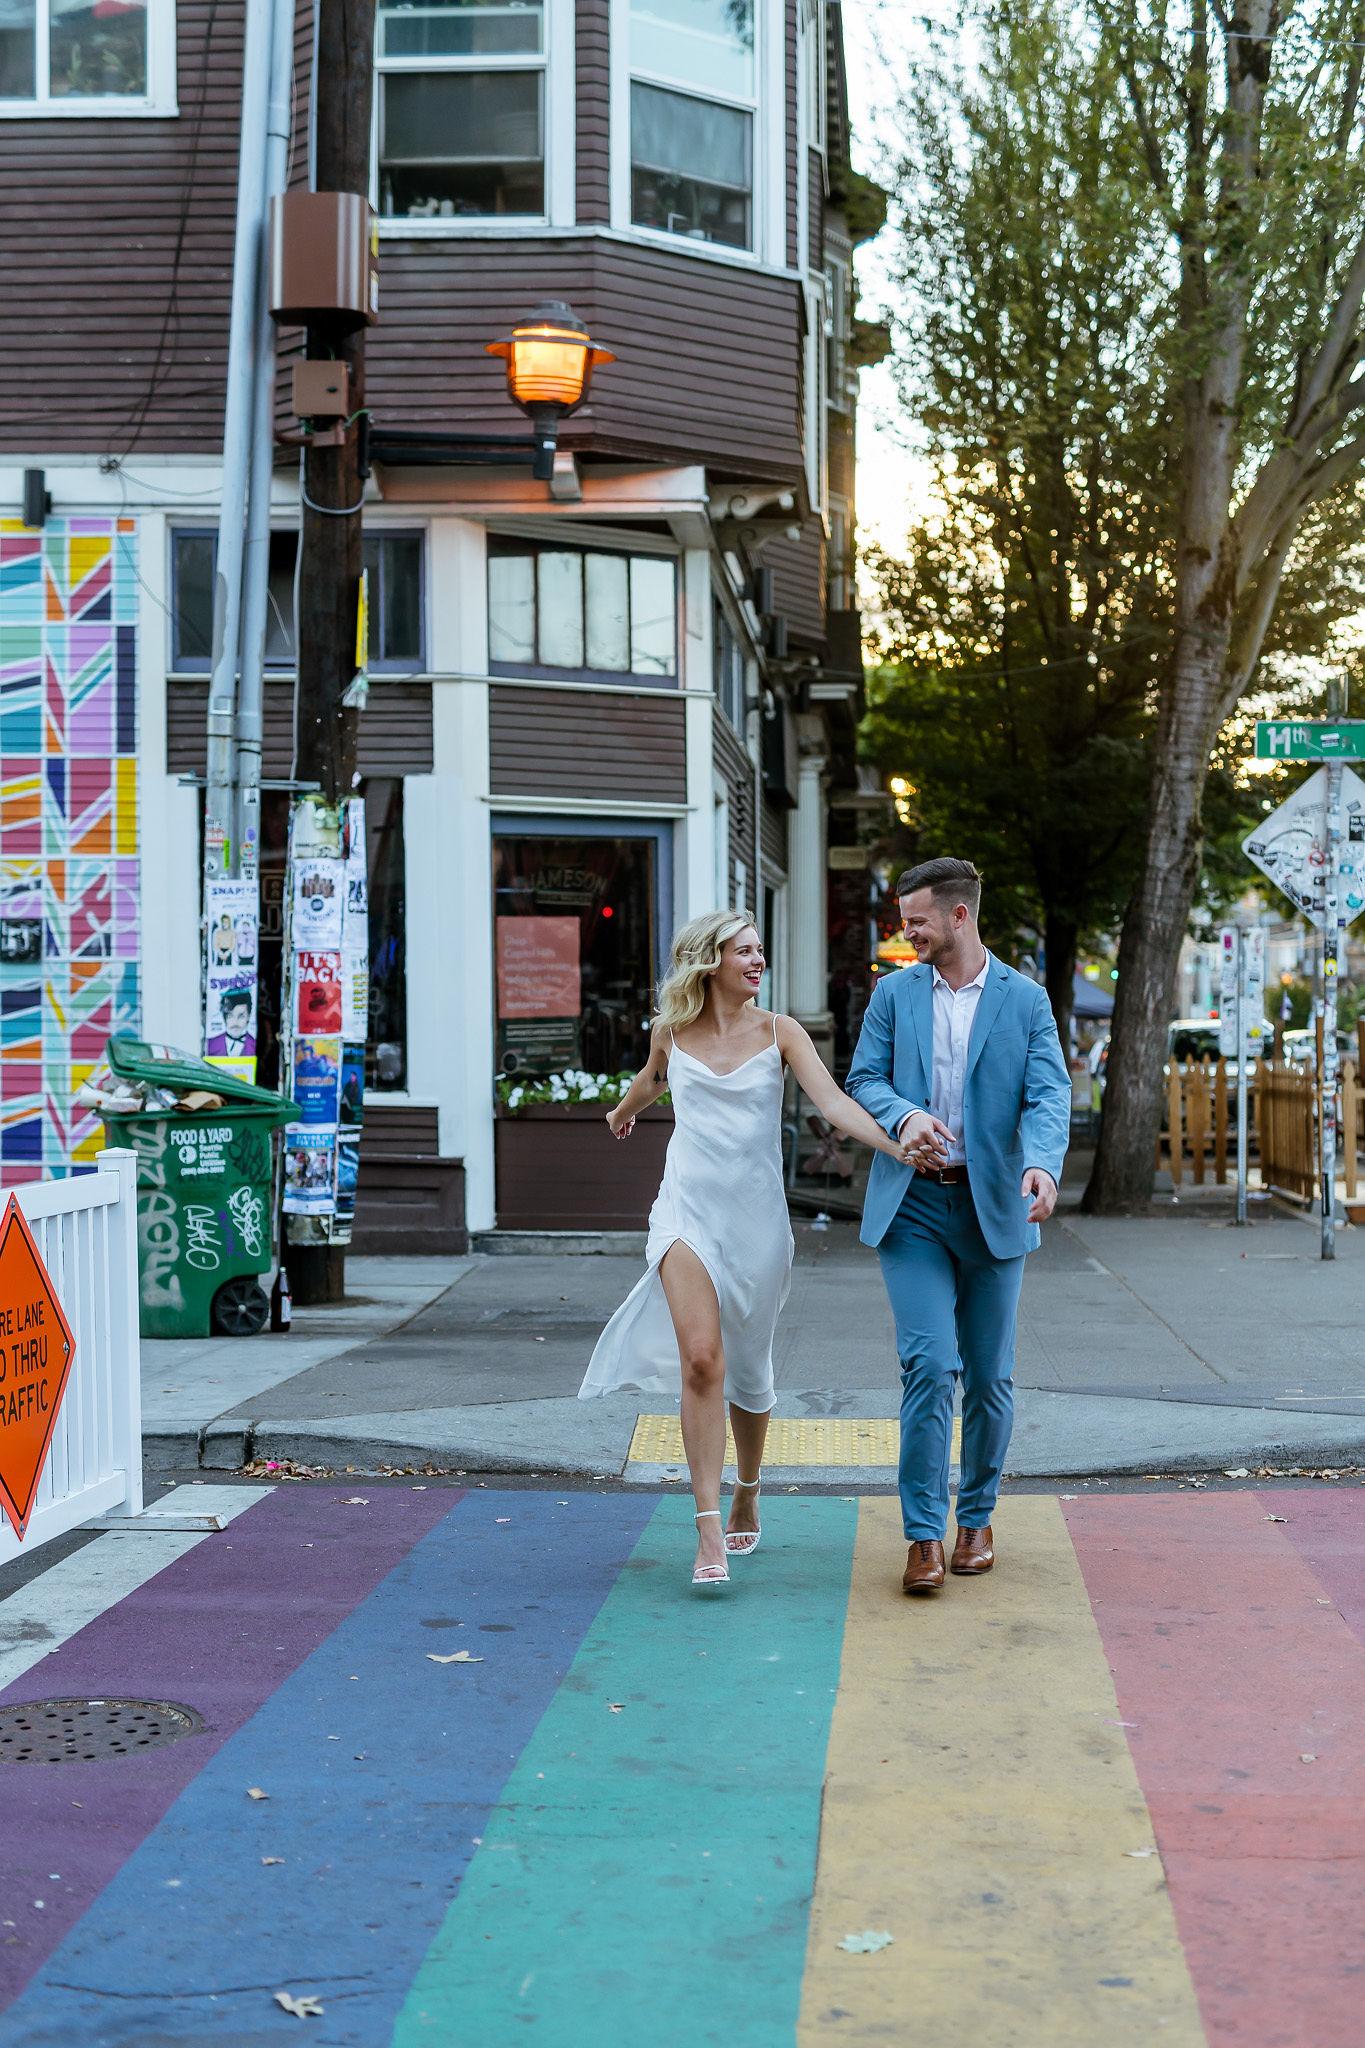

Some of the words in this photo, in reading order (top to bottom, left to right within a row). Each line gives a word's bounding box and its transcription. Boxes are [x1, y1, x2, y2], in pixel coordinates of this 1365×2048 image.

[530, 868, 608, 893] JAMESON
[304, 953, 337, 968] IT'S
[298, 967, 343, 984] BACK
[171, 1129, 198, 1146] FOOD
[198, 1129, 206, 1144] &
[206, 1127, 233, 1143] YARD
[17, 1300, 45, 1332] LANE
[12, 1335, 48, 1377] THRU
